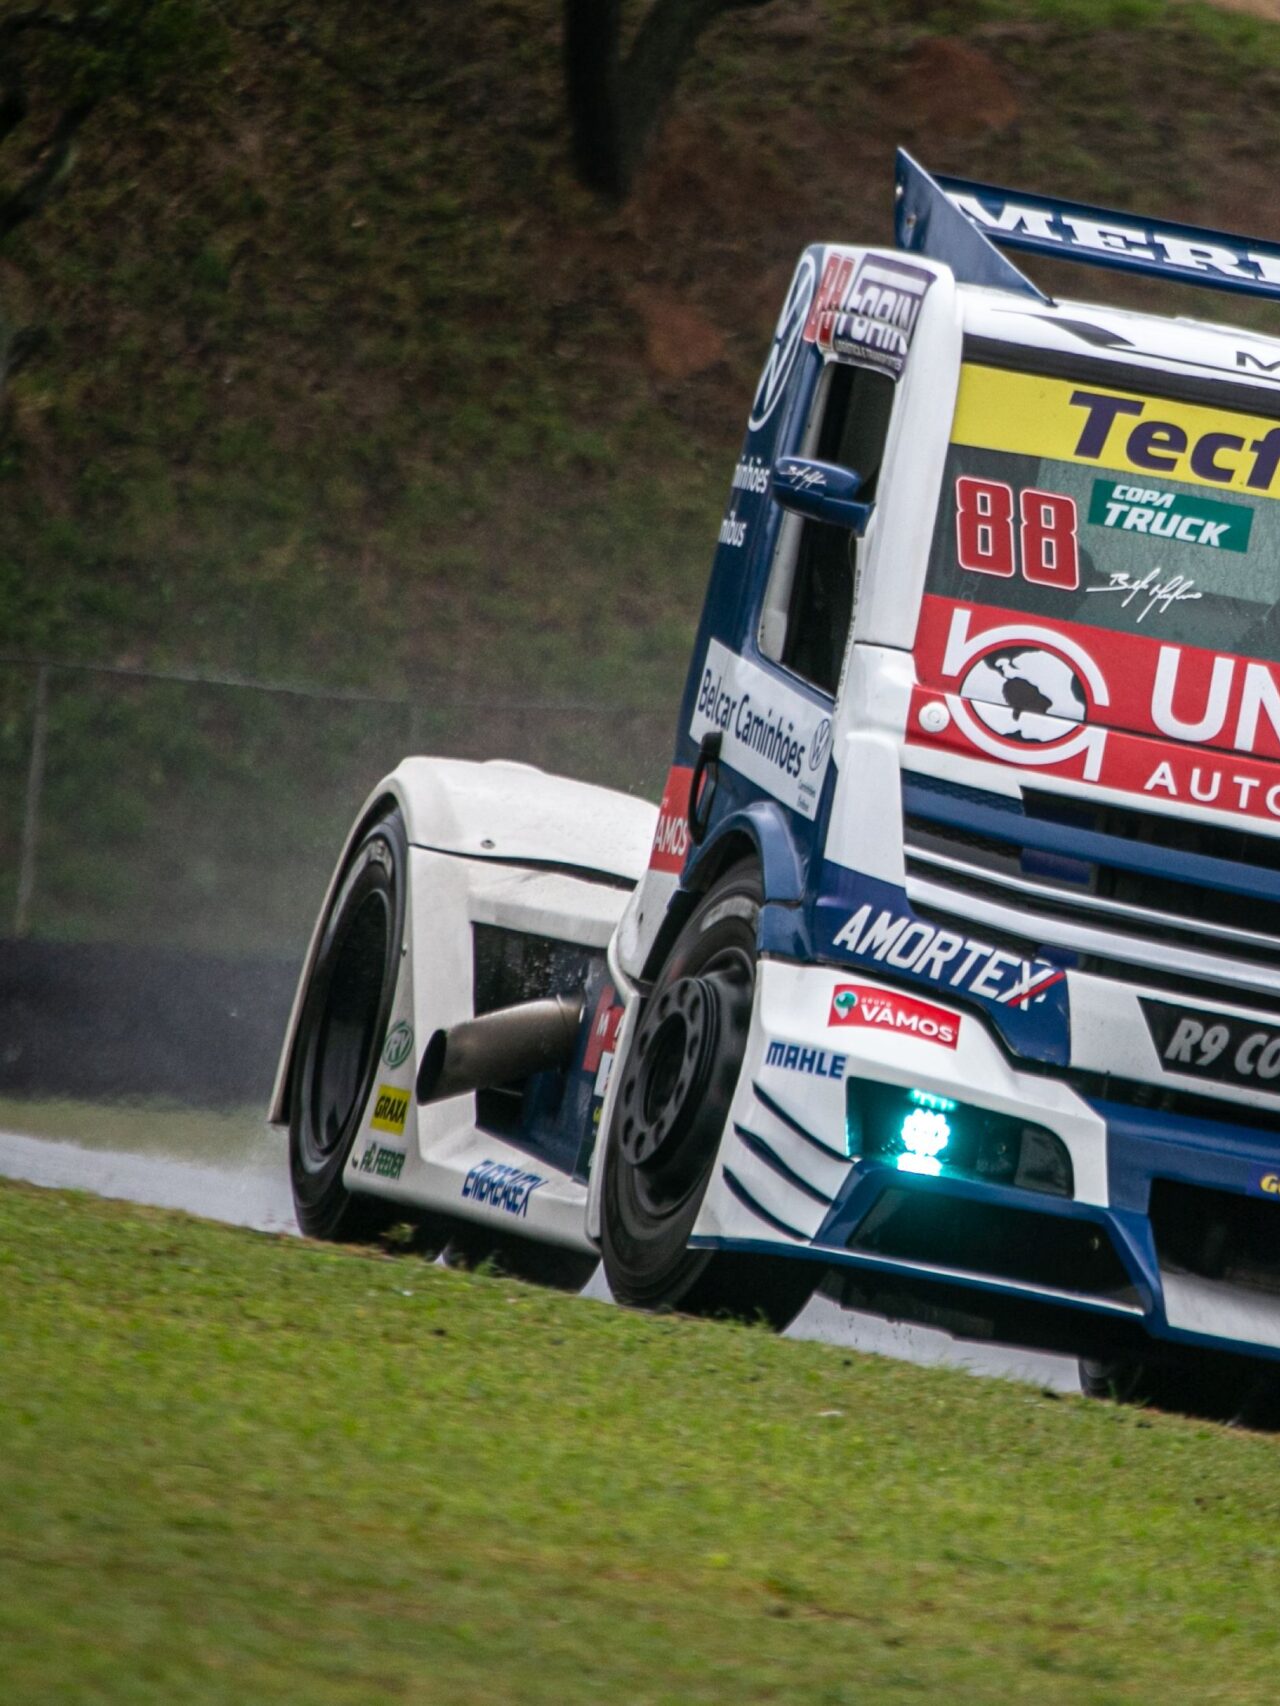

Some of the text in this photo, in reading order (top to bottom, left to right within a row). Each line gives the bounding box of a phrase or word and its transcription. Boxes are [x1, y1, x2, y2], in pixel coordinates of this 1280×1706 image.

[1111, 483, 1177, 509] COPA
[956, 476, 1080, 591] 88
[1103, 501, 1231, 548] TRUCK
[698, 668, 806, 779] Belcar Caminhões
[831, 904, 1060, 1012] AMORTEX
[860, 1002, 954, 1043] VAMOS
[1164, 1018, 1230, 1067] R9
[765, 1040, 847, 1080] MAHLE
